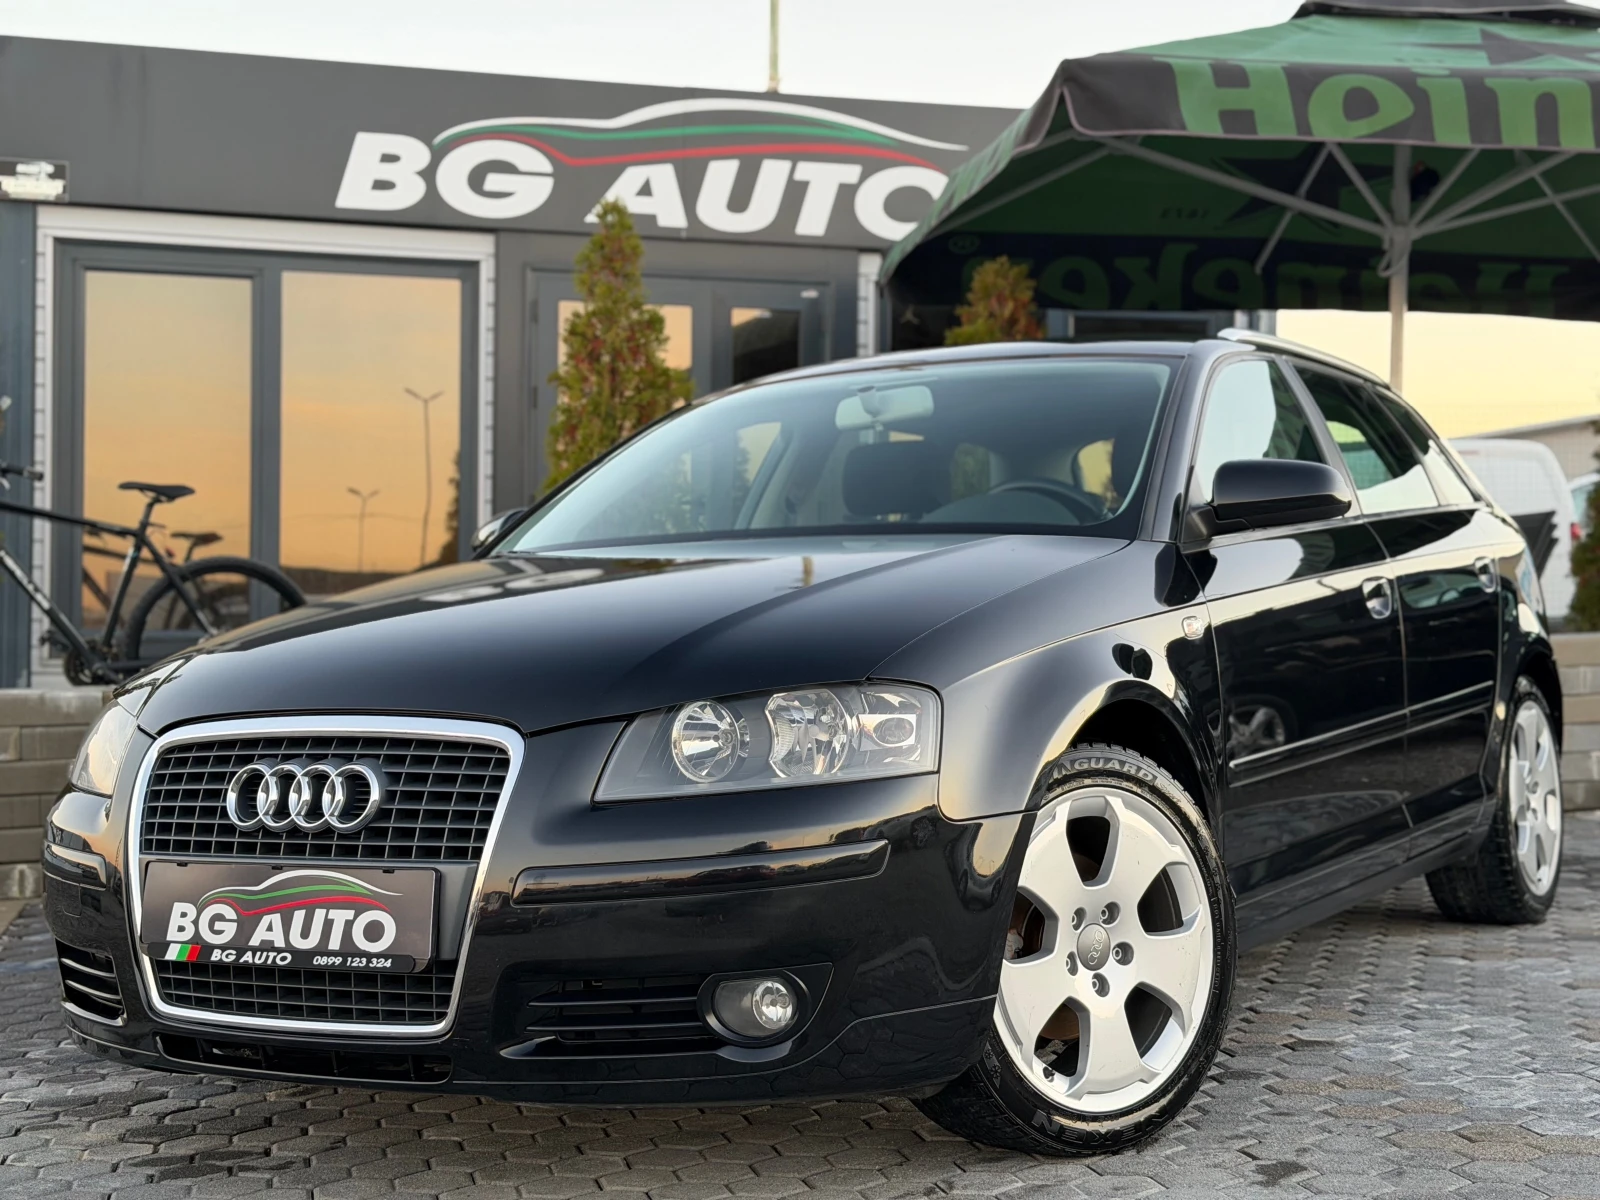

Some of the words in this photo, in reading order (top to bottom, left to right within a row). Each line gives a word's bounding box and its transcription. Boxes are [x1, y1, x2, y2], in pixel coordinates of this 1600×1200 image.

[1154, 57, 1596, 149] Hein
[335, 131, 554, 219] BG
[584, 158, 949, 242] AUTO
[166, 902, 238, 945] BG
[248, 908, 397, 953] AUTO
[210, 949, 236, 963] BG
[240, 949, 292, 965] AUTO
[312, 955, 342, 967] 0899
[346, 956, 366, 968] 123
[369, 957, 392, 968] 324
